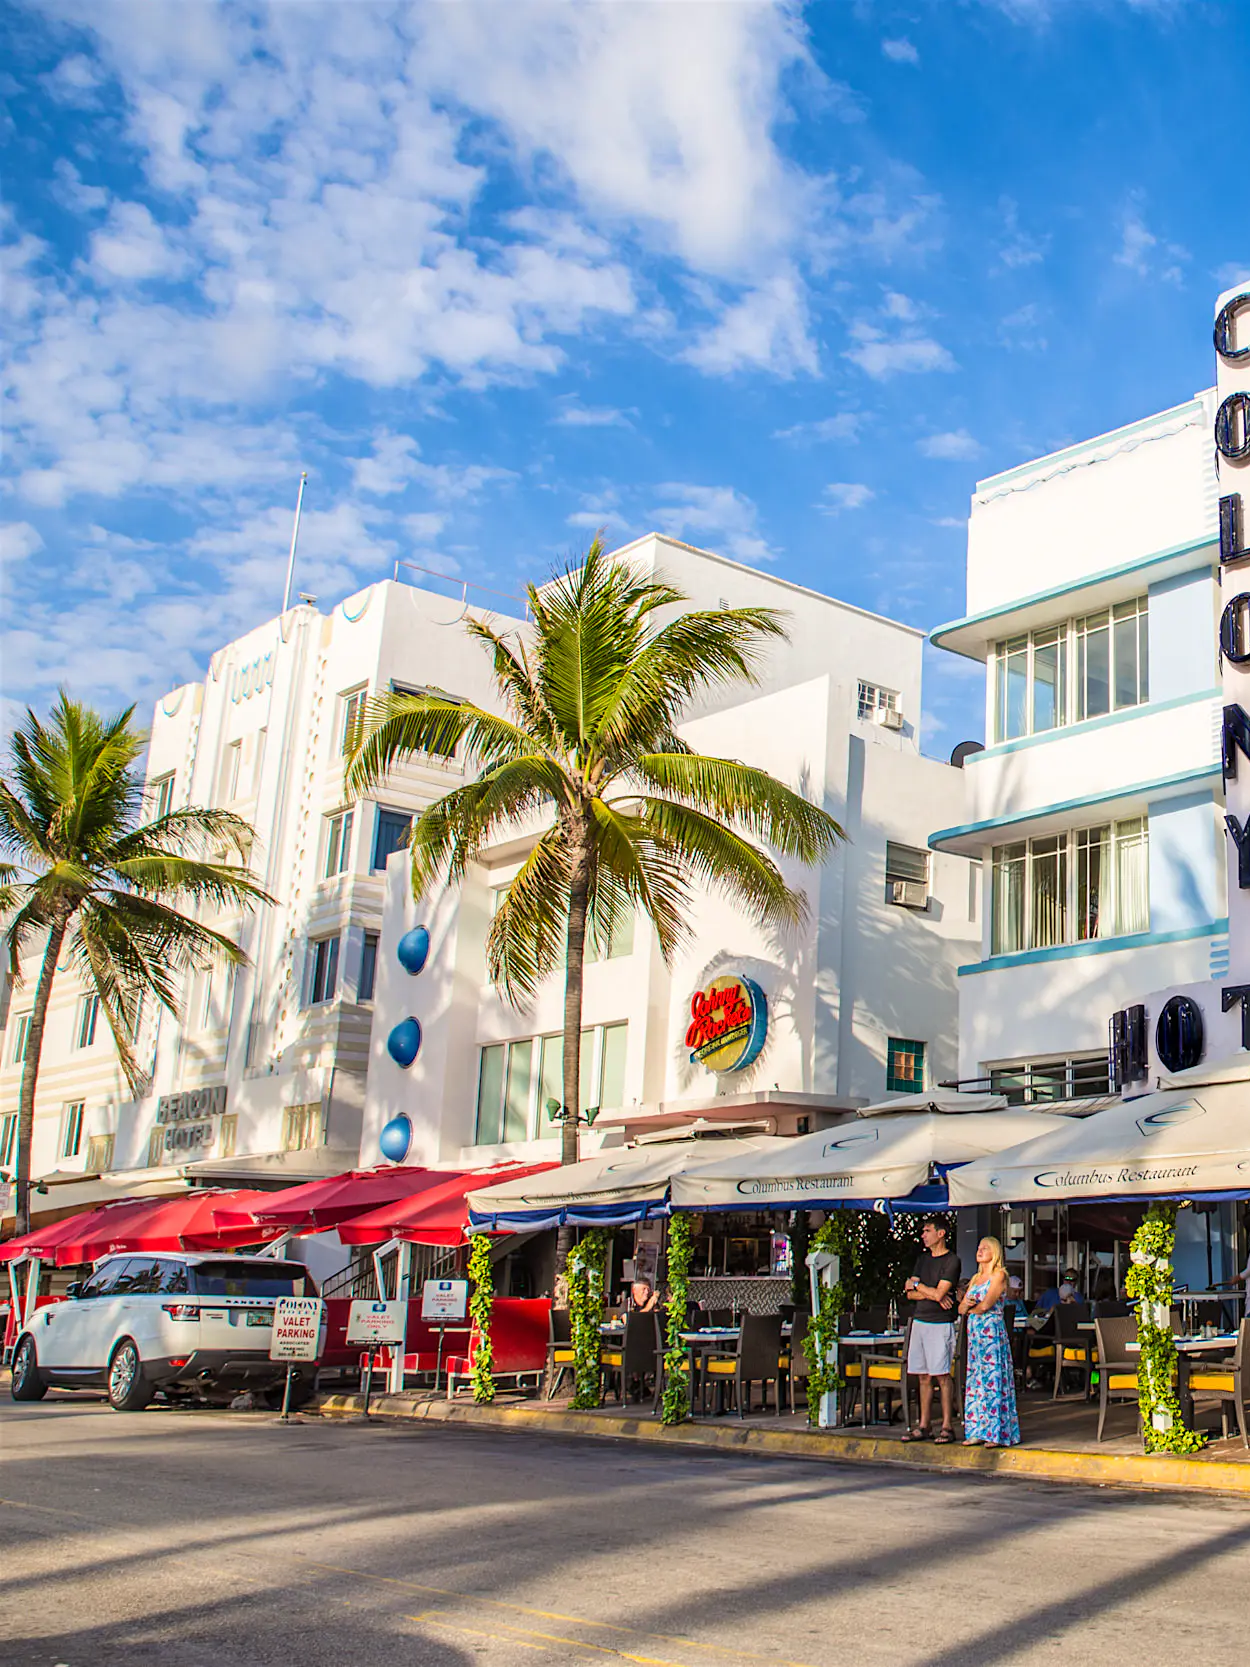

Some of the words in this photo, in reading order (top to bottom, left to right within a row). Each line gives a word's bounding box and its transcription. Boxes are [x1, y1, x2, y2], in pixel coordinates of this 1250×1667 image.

[691, 984, 745, 1018] Johnny
[685, 1002, 752, 1049] Rockets
[156, 1085, 228, 1125] BEACON
[164, 1123, 213, 1151] HOTEL
[736, 1177, 795, 1195] Columbus
[796, 1175, 855, 1191] Restaurant
[1033, 1169, 1113, 1188] Columbus
[1117, 1164, 1200, 1183] Restaurant
[276, 1328, 315, 1339] PARKING
[282, 1316, 311, 1327] VALET
